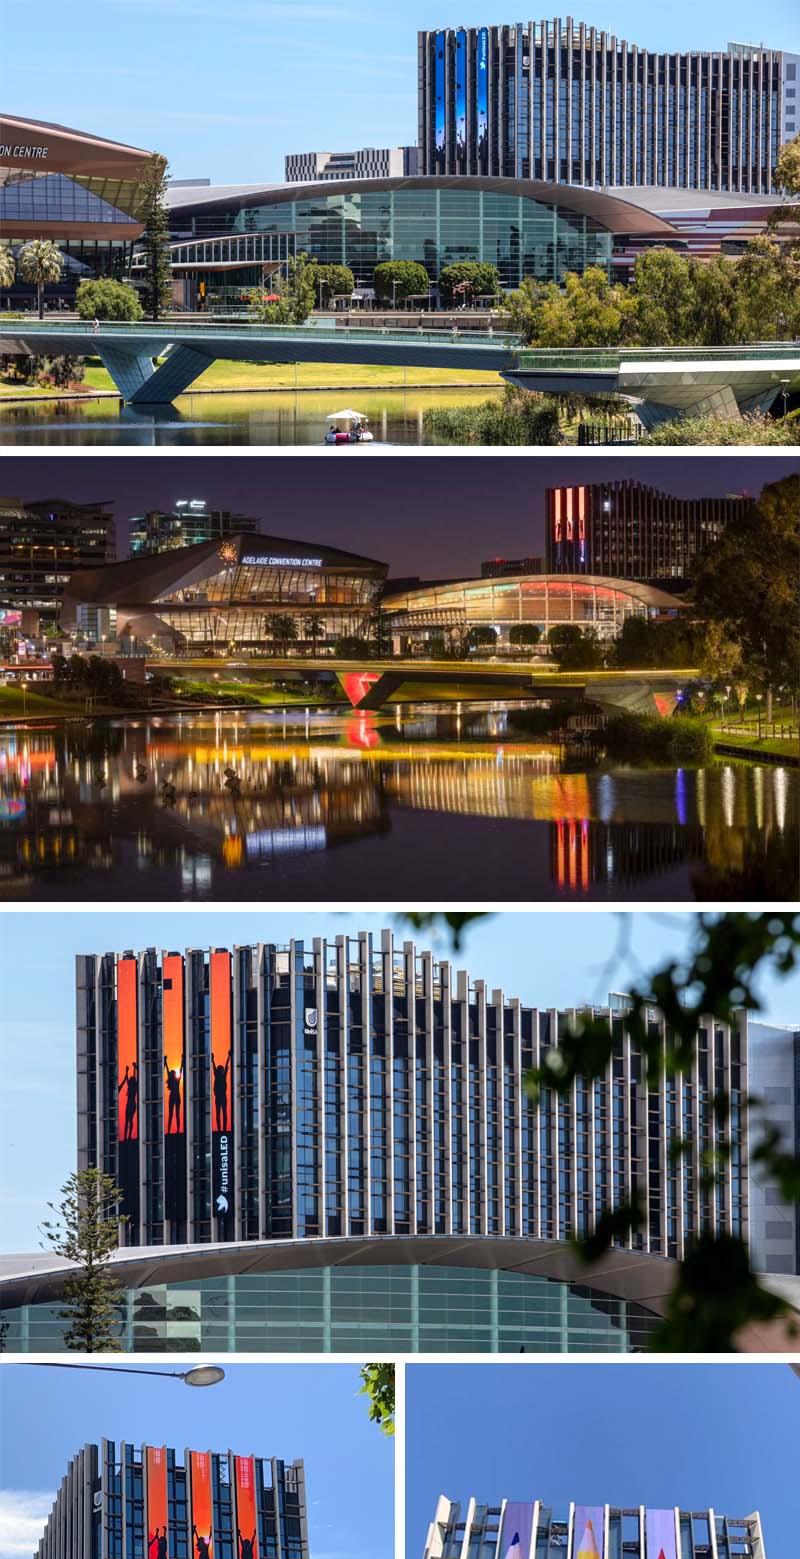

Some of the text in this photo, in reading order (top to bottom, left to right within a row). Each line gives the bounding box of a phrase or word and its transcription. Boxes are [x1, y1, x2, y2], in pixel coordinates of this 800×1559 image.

[13, 146, 49, 158] CENTRE
[242, 556, 323, 567] ADELAIDE CONVENTION CENTRE
[220, 1135, 229, 1194] #unisaLED
